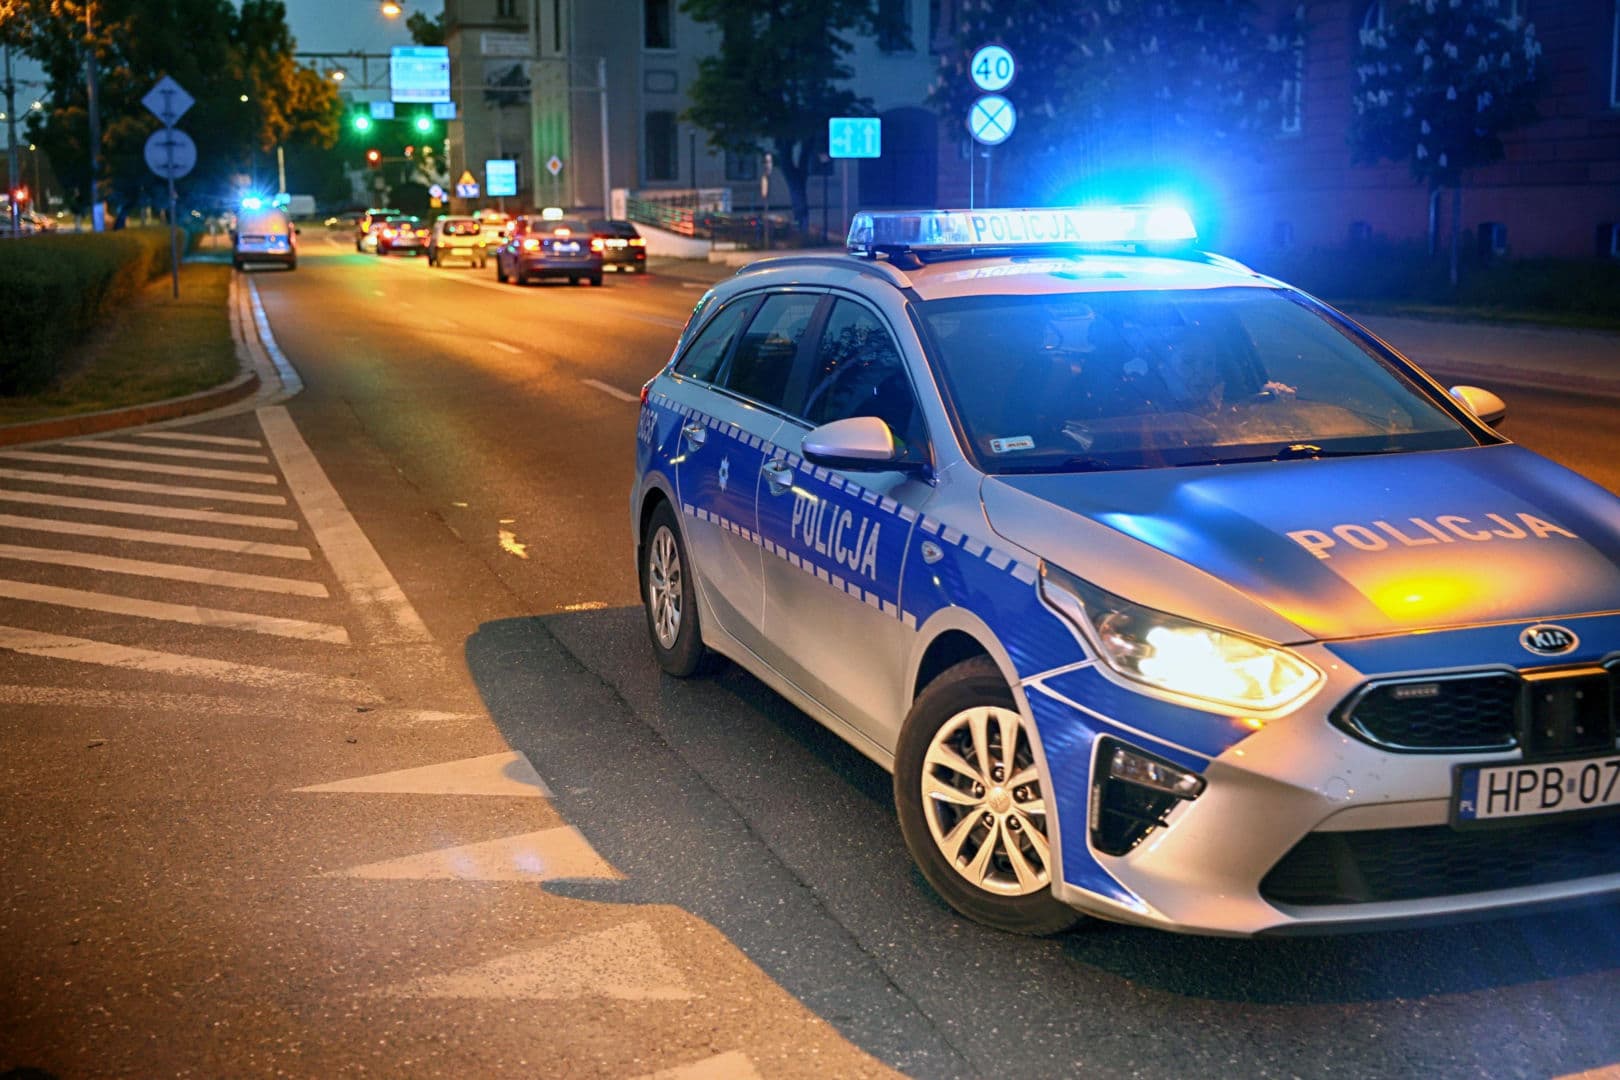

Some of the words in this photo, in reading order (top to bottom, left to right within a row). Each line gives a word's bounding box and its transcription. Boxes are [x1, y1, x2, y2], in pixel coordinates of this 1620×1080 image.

[976, 57, 1010, 80] 40
[972, 214, 1081, 242] POLICJA
[791, 495, 881, 581] POLICJA
[1286, 513, 1579, 559] POLICJA
[1534, 631, 1569, 647] KIA
[1487, 767, 1564, 814] HPB
[1579, 760, 1620, 803] 07
